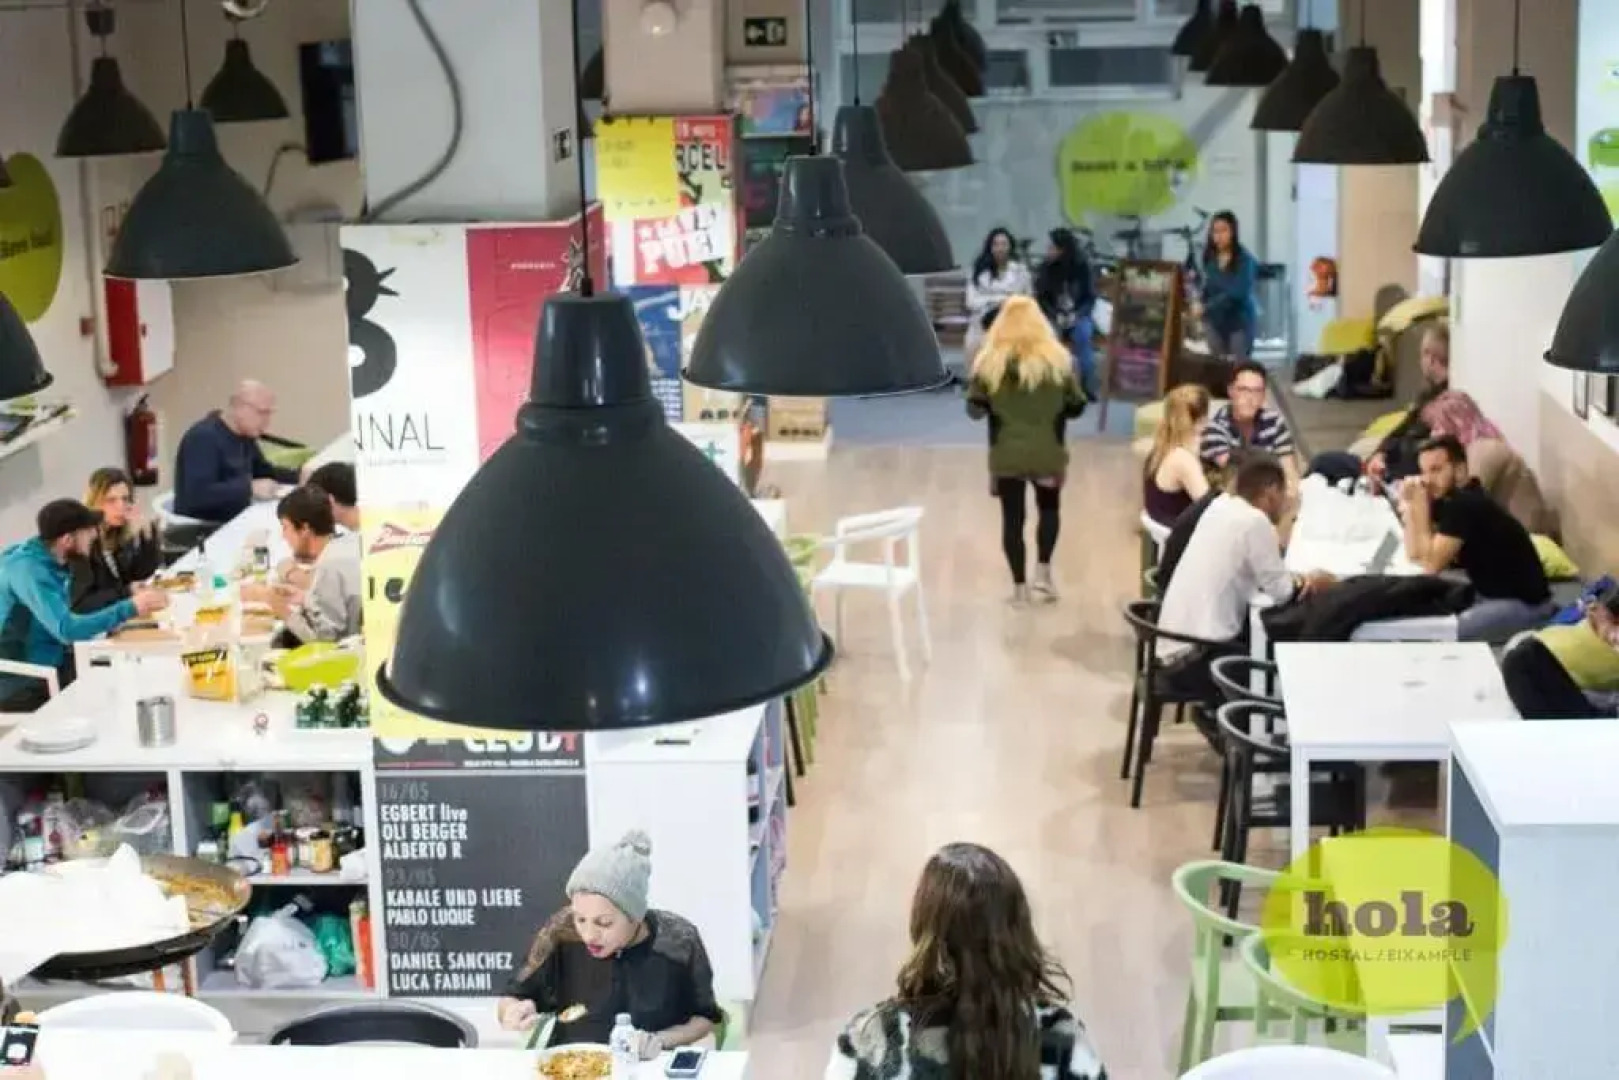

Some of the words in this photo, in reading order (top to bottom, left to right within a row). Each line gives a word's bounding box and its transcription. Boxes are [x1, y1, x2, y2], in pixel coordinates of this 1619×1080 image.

[380, 803, 437, 822] EGBERT
[440, 802, 468, 821] live
[382, 822, 407, 840] OLI
[411, 822, 469, 840] BERGER
[383, 840, 448, 860] ALBERTO
[386, 888, 441, 907] KABALE
[445, 888, 477, 907] UND
[482, 888, 523, 907] LIEBE
[387, 907, 428, 926] PABLO
[431, 907, 477, 926] LUQUE
[390, 951, 444, 970] DANIEL
[447, 951, 514, 970] SANCHEZ
[391, 973, 431, 991] LUCA
[434, 973, 493, 991] FABIANI
